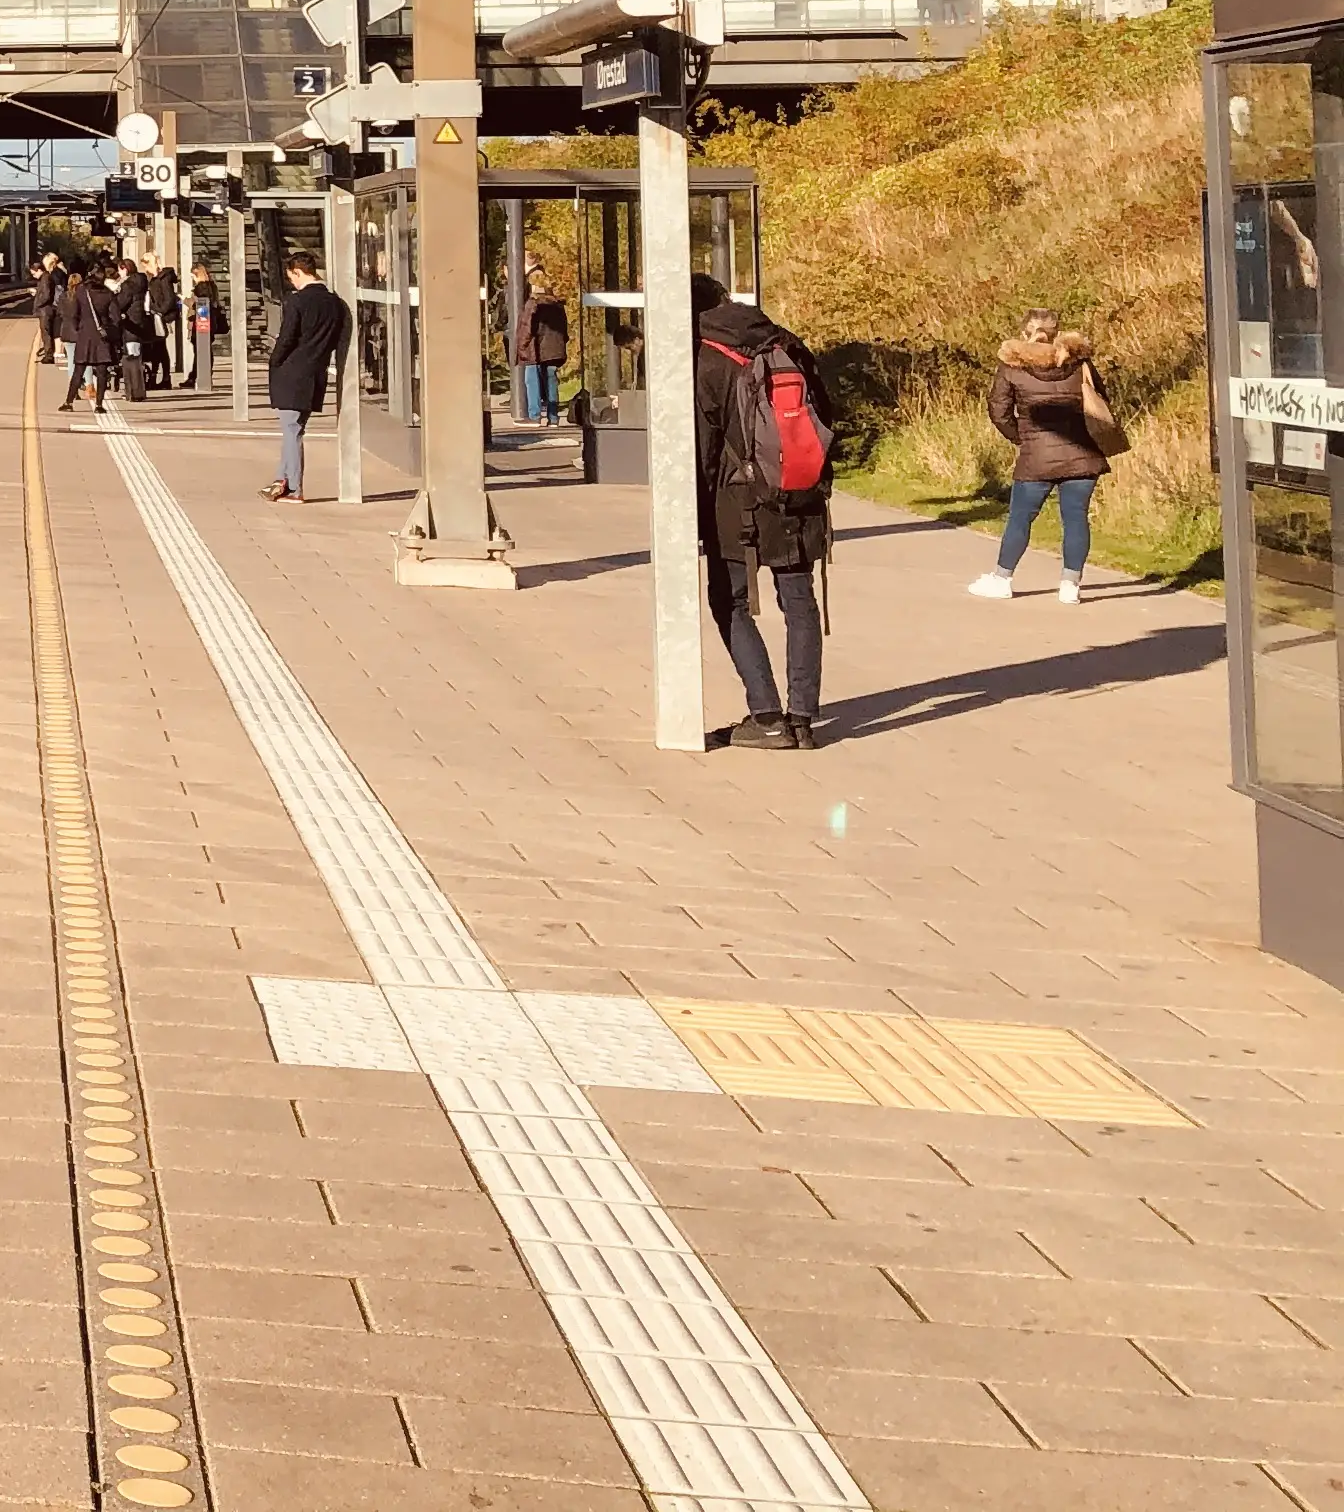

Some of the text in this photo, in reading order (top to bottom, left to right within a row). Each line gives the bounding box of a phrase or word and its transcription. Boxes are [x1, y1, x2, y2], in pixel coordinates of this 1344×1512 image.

[596, 52, 627, 90] Ørestad
[301, 76, 316, 93] 2
[123, 164, 132, 175] 2
[140, 164, 171, 183] 80
